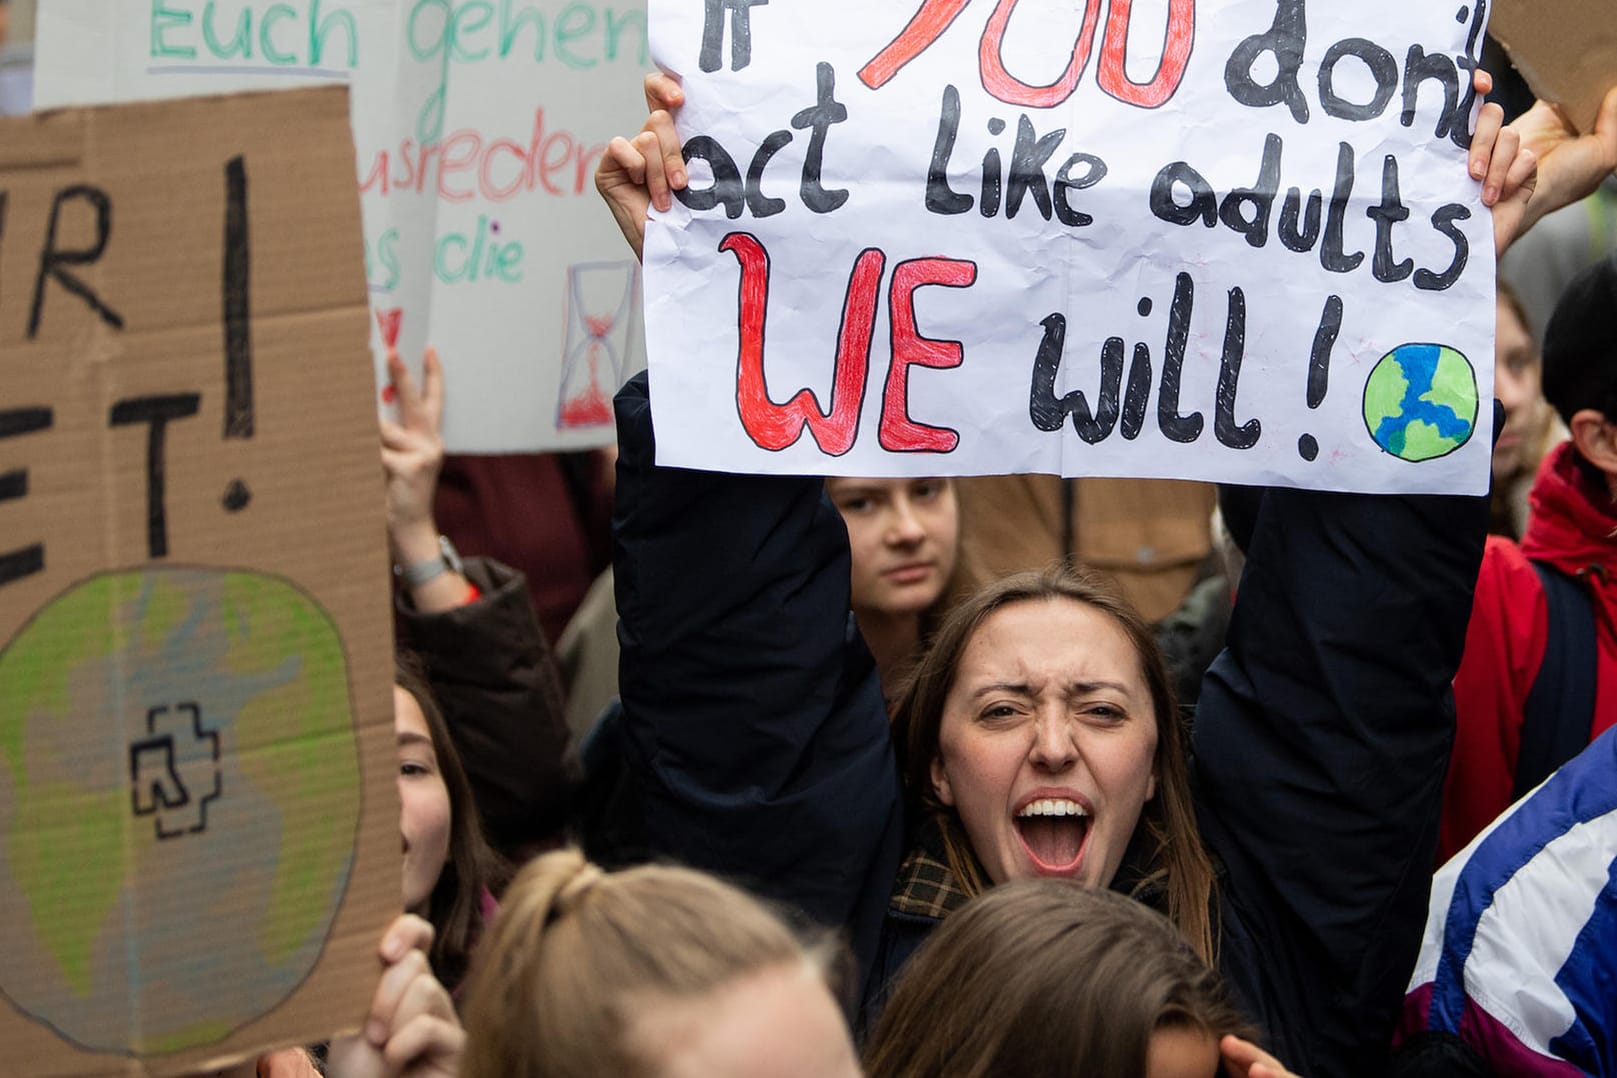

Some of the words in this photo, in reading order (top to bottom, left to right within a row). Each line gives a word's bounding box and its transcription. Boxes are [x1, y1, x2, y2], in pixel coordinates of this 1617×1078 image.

[150, 0, 358, 67] Euch
[672, 62, 849, 219] act
[1149, 133, 1471, 291] adults
[718, 232, 978, 456] WE
